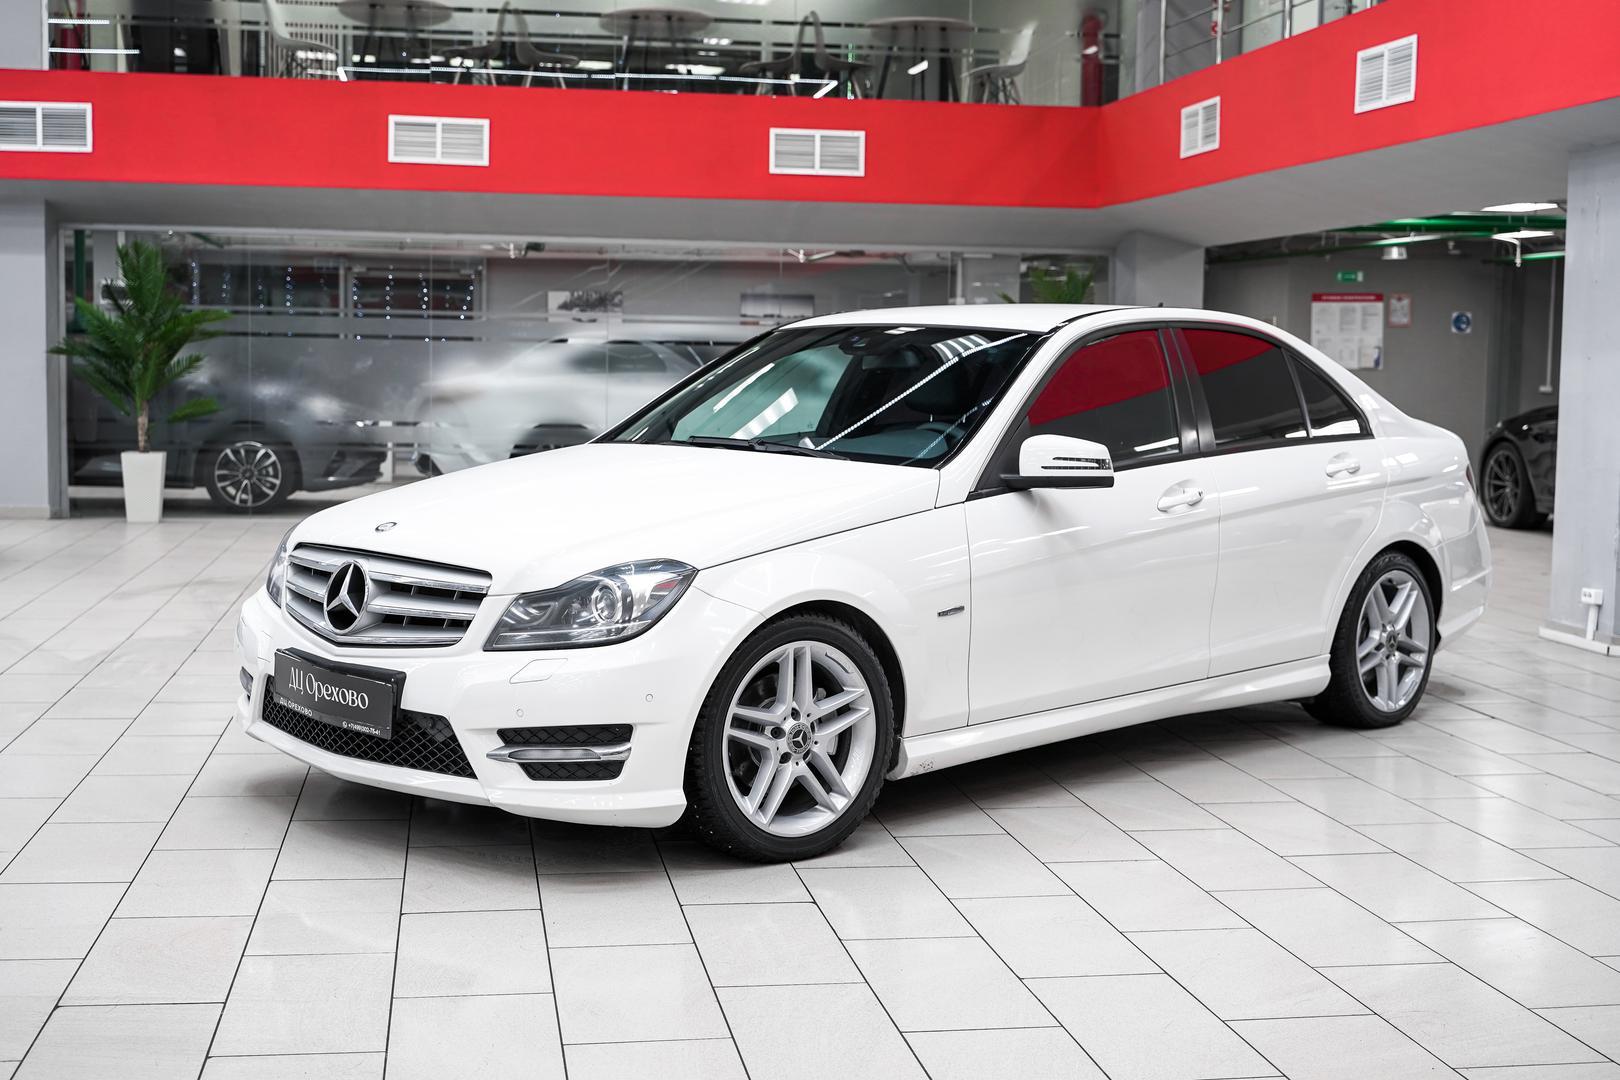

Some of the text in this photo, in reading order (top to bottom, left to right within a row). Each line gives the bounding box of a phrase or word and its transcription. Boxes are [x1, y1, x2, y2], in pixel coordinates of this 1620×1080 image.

[289, 667, 369, 709] ДЦ Орехово
[280, 697, 313, 717] ДЦ ОРЕХОВО
